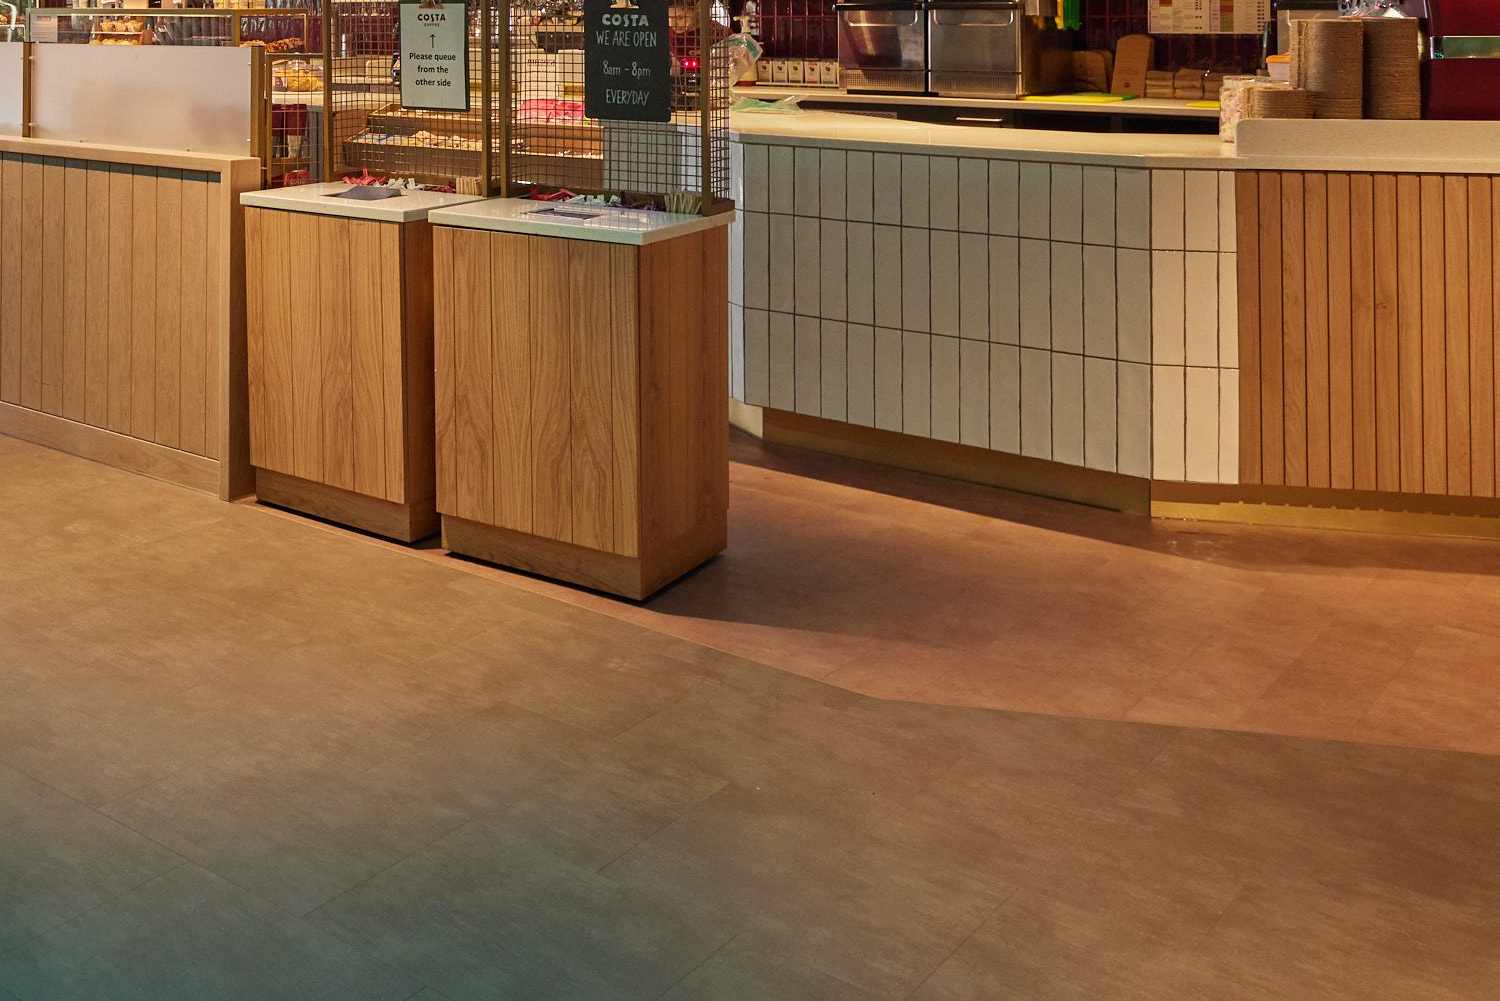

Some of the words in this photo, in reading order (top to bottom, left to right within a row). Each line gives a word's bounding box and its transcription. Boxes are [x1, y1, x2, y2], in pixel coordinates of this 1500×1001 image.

[417, 13, 446, 22] COSTA
[601, 13, 649, 27] COSTA
[595, 30, 610, 45] WE
[612, 30, 631, 47] ARE
[633, 31, 657, 47] OPEN
[409, 52, 433, 60] Please
[434, 53, 456, 61] queue
[417, 65, 435, 73] from
[436, 65, 449, 74] the
[603, 60, 620, 75] 8am
[631, 61, 651, 80] 8pm
[415, 78, 435, 86] other
[437, 79, 451, 87] side
[606, 88, 650, 106] EVERYDAY
